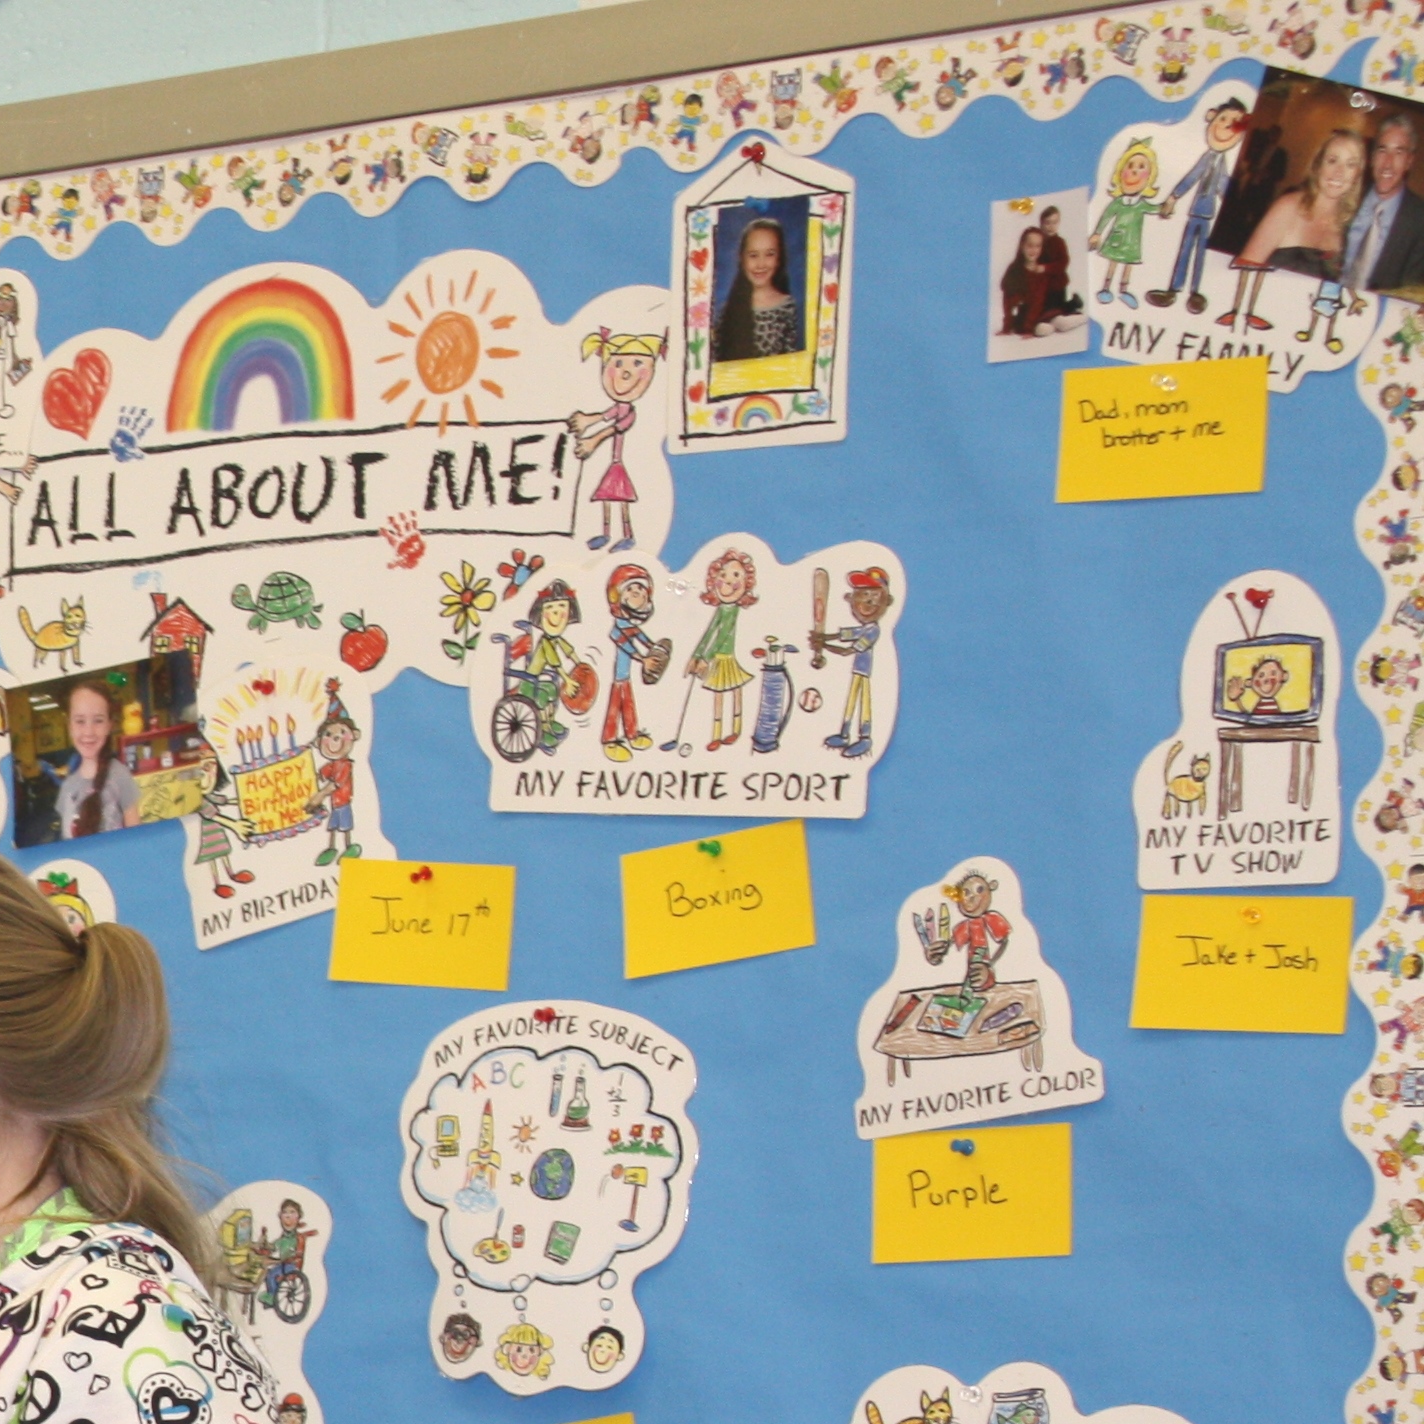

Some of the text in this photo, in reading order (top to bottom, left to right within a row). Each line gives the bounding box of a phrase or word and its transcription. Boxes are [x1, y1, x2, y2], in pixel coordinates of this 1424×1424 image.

[1107, 321, 1166, 355] MY
[1135, 400, 1189, 418] mom
[1192, 420, 1226, 439] me
[26, 431, 568, 550] ALL ABOUT ME!
[514, 768, 851, 802] MY FAVORITE SPORT
[1145, 817, 1332, 850] MY FAVORITE
[1170, 849, 1304, 876] TV SHOW
[664, 868, 764, 918] Boxing
[201, 909, 234, 938] MY
[369, 895, 492, 938] June 17th
[1175, 935, 1238, 967] Jake
[1262, 943, 1319, 973] Josh
[433, 1010, 685, 1072] MY FAVORITE SUBJECT
[858, 1067, 1098, 1129] MY FAVORITE COLOR
[907, 1168, 1009, 1211] Purple
